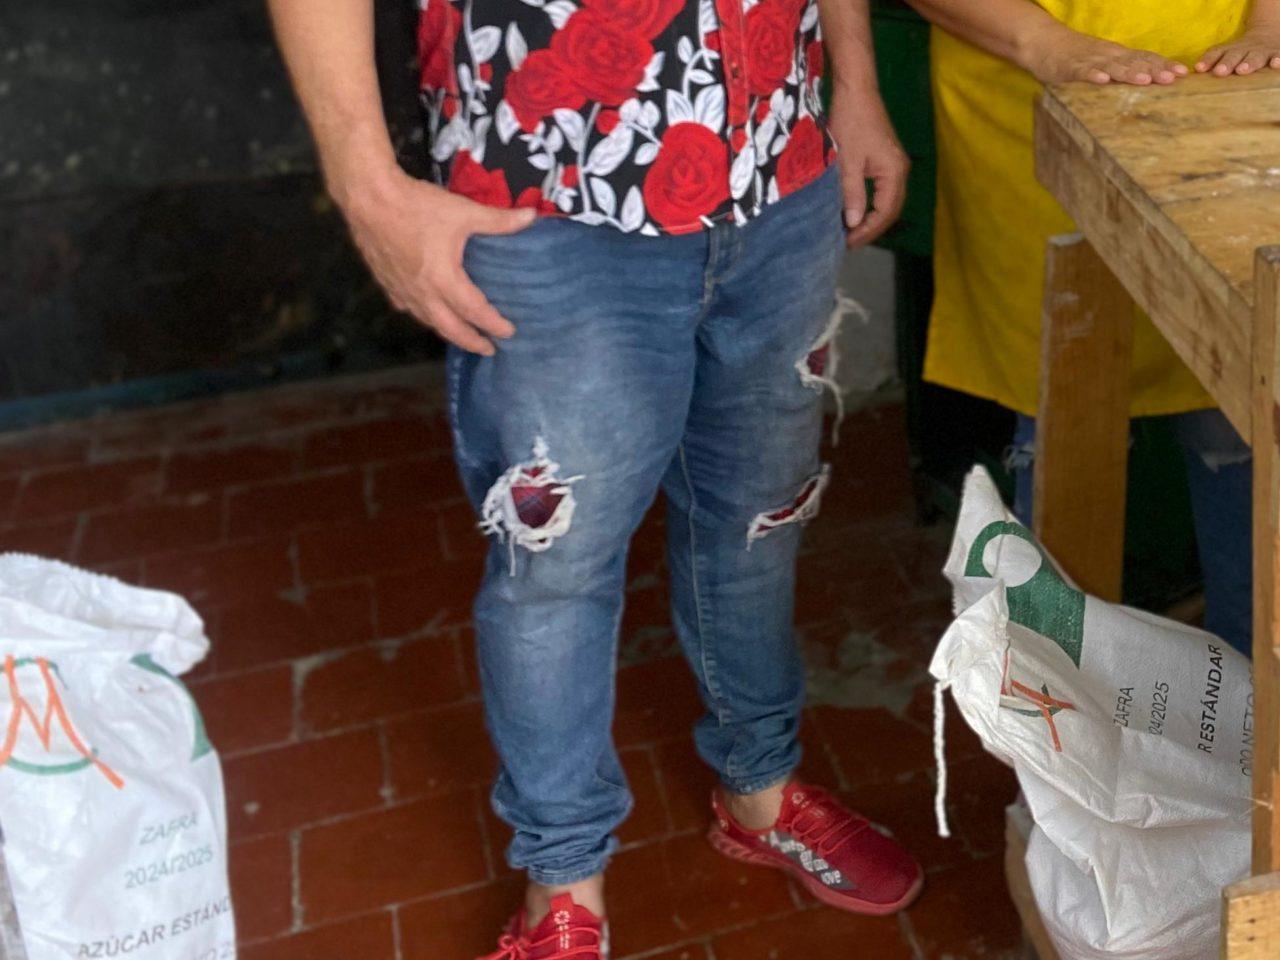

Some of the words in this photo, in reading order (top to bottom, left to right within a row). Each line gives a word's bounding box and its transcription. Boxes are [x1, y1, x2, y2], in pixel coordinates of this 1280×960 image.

[1113, 686, 1135, 728] ZAFRA
[1200, 643, 1224, 742] ESTÁNDAR
[138, 812, 198, 845] ZAFRA
[124, 844, 213, 889] 2024/2025
